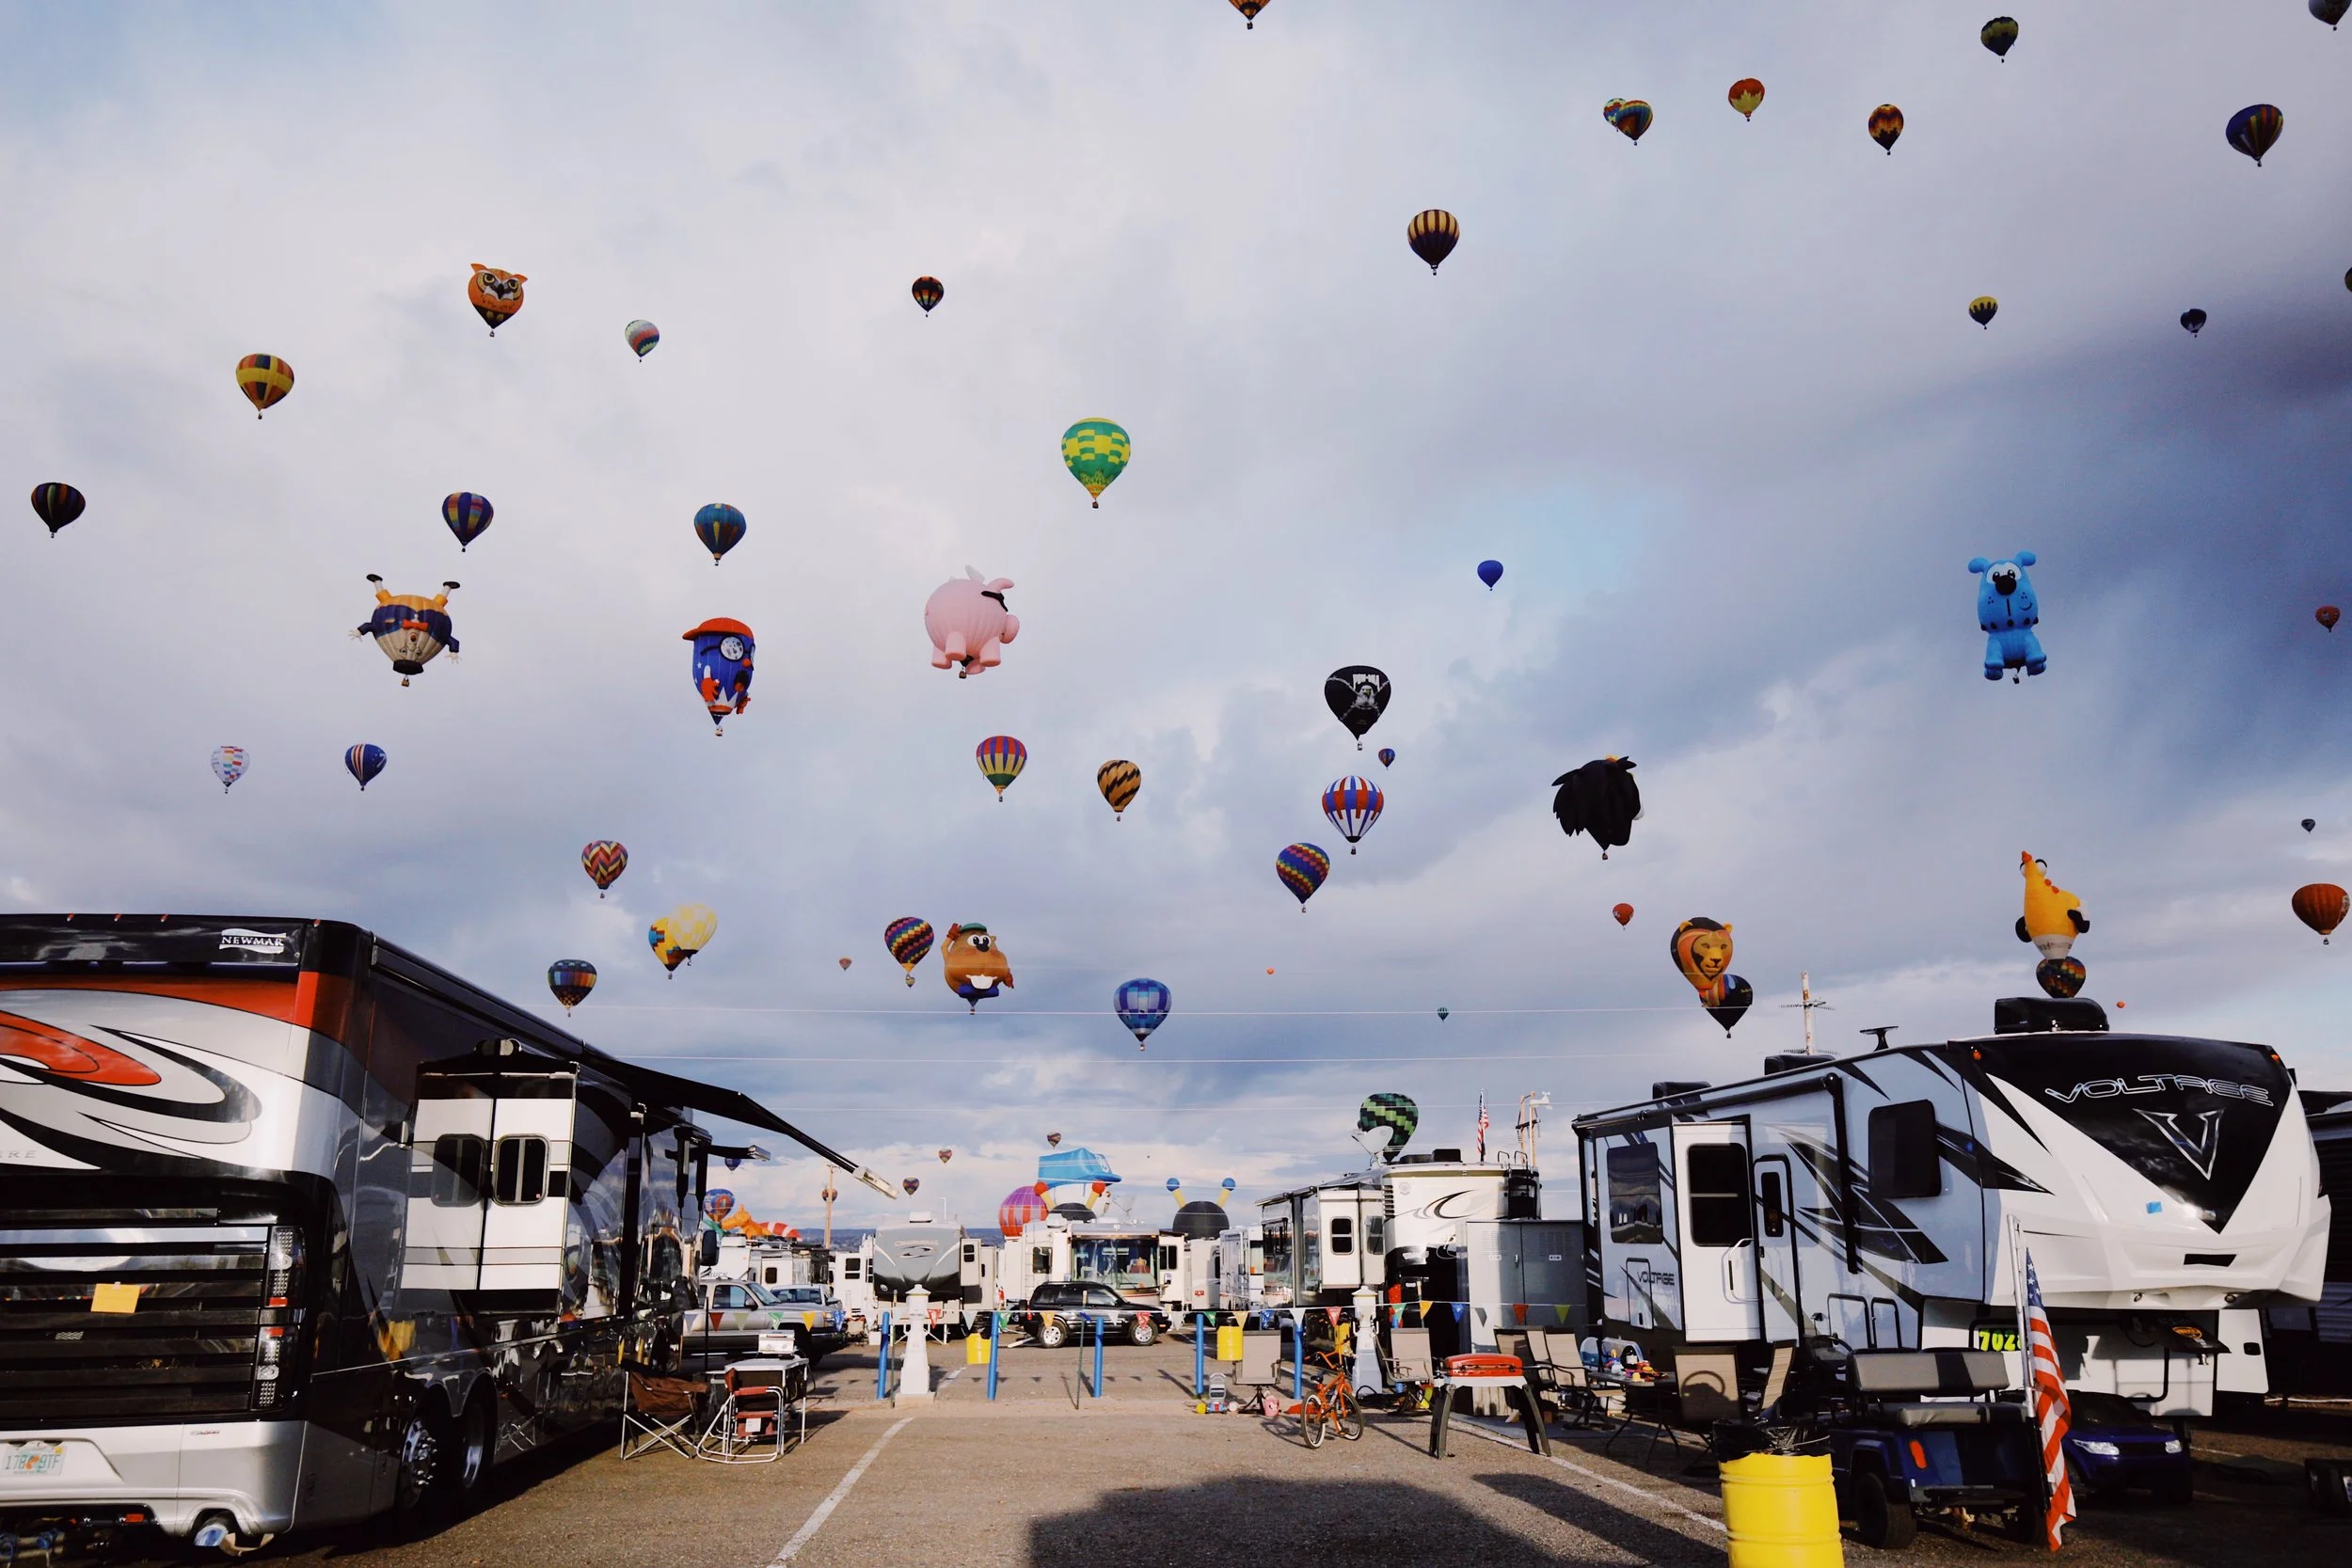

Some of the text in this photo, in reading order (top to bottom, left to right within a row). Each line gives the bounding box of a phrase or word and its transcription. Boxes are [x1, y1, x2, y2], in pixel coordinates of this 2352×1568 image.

[221, 936, 284, 946] NEWMAR
[2044, 1074, 2274, 1107] VOLTAGE
[1637, 1271, 1675, 1286] VOLTAGE
